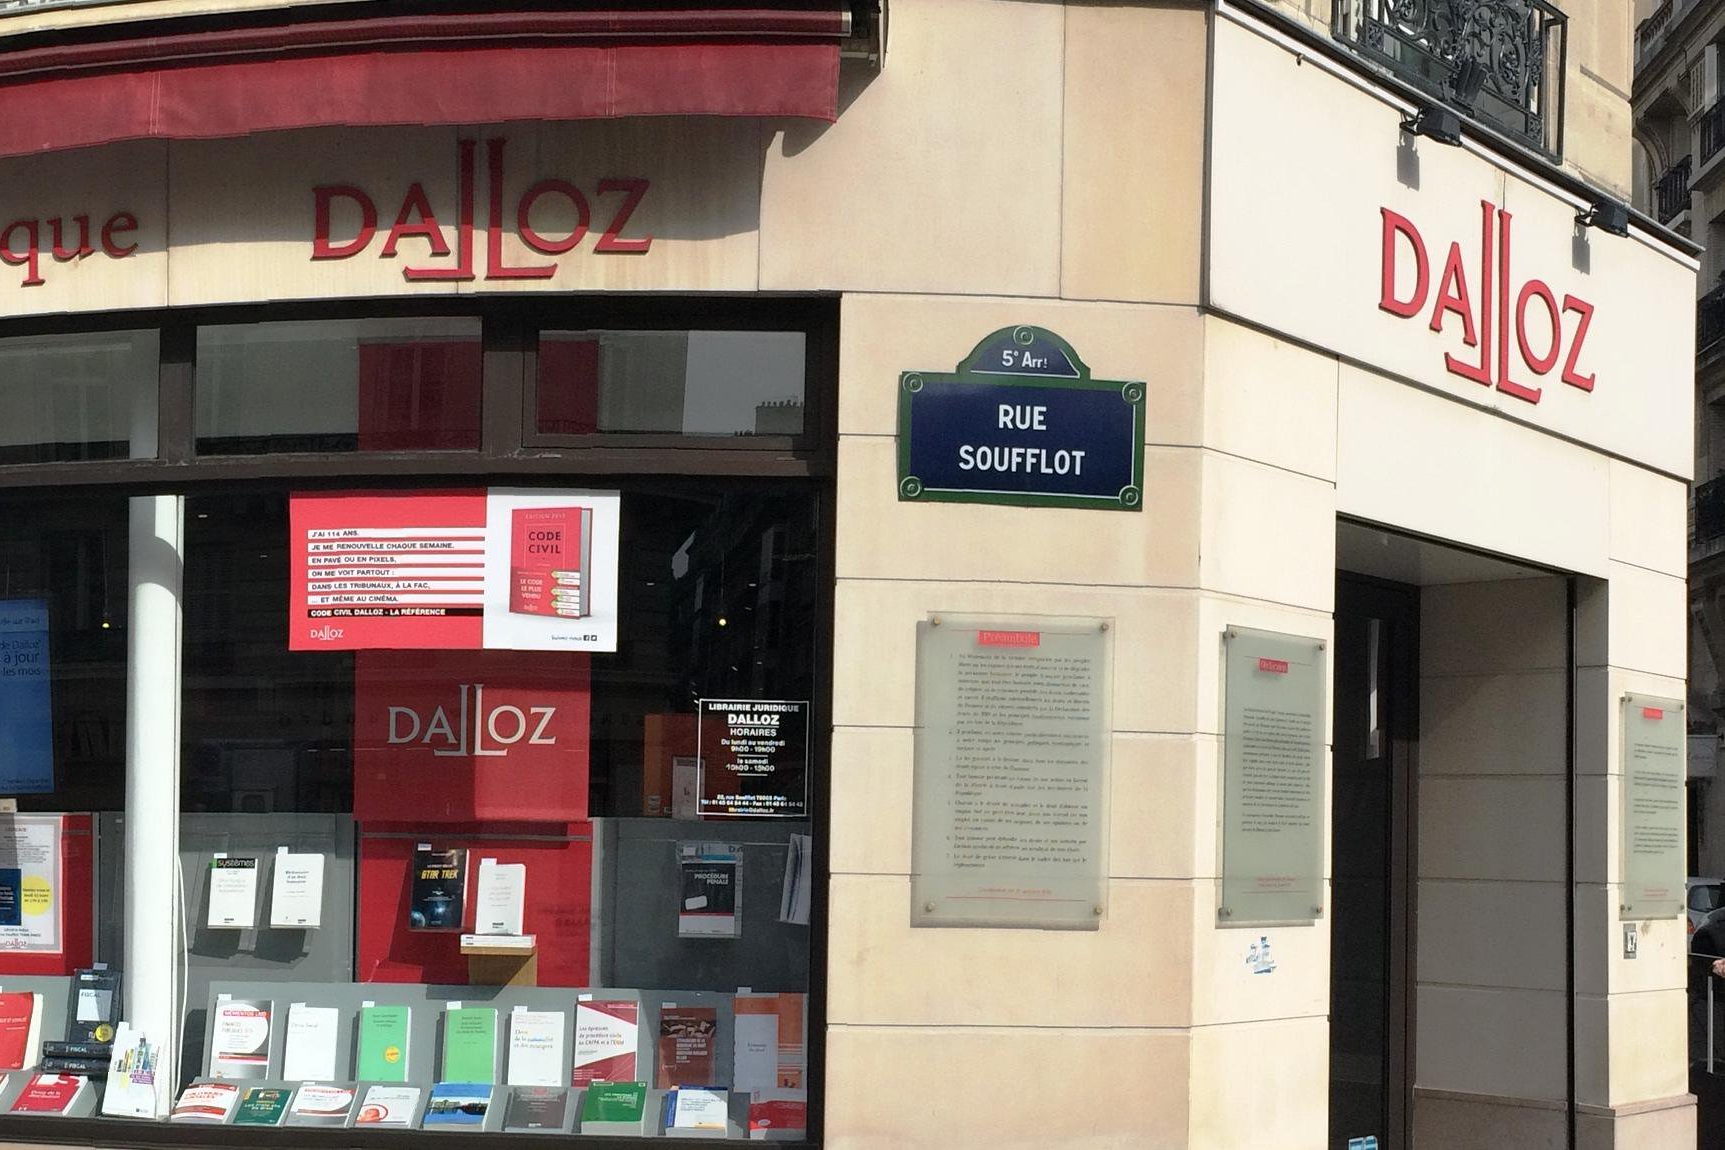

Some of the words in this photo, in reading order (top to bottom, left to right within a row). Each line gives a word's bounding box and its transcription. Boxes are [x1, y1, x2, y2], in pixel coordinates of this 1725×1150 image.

[310, 137, 653, 281] DALLOZ
[1378, 200, 1595, 404] DALLOZ
[999, 404, 1047, 431] RUE
[958, 445, 1086, 476] SOUFFLOT
[528, 531, 562, 541] CODE
[528, 544, 562, 554] CIVIL
[350, 582, 394, 590] TRIBUNAUX,
[311, 609, 332, 617] CODE
[333, 608, 353, 616] CIVIL
[354, 608, 384, 616] DALLOZ
[401, 607, 446, 615] RÉFÉRENCE
[310, 625, 344, 640] DALLOZ
[982, 631, 1038, 646] Préambule
[4, 651, 11, 663] à
[14, 652, 40, 666] jour
[3, 666, 16, 676] les
[18, 666, 42, 676] mois
[708, 703, 751, 711] LIBRAIRIE
[752, 704, 800, 712] JURIDIQUE
[388, 684, 557, 757] DALLOZ
[727, 714, 780, 725] DALLOZ
[730, 728, 777, 737] HORAIRES
[731, 738, 748, 746] lundi
[217, 858, 255, 868] systèmes
[421, 869, 439, 880] STAR
[442, 869, 459, 880] TREK
[80, 991, 102, 999] FISCAL
[69, 1046, 87, 1054] FISCAL
[68, 1062, 86, 1070] FISCAL
